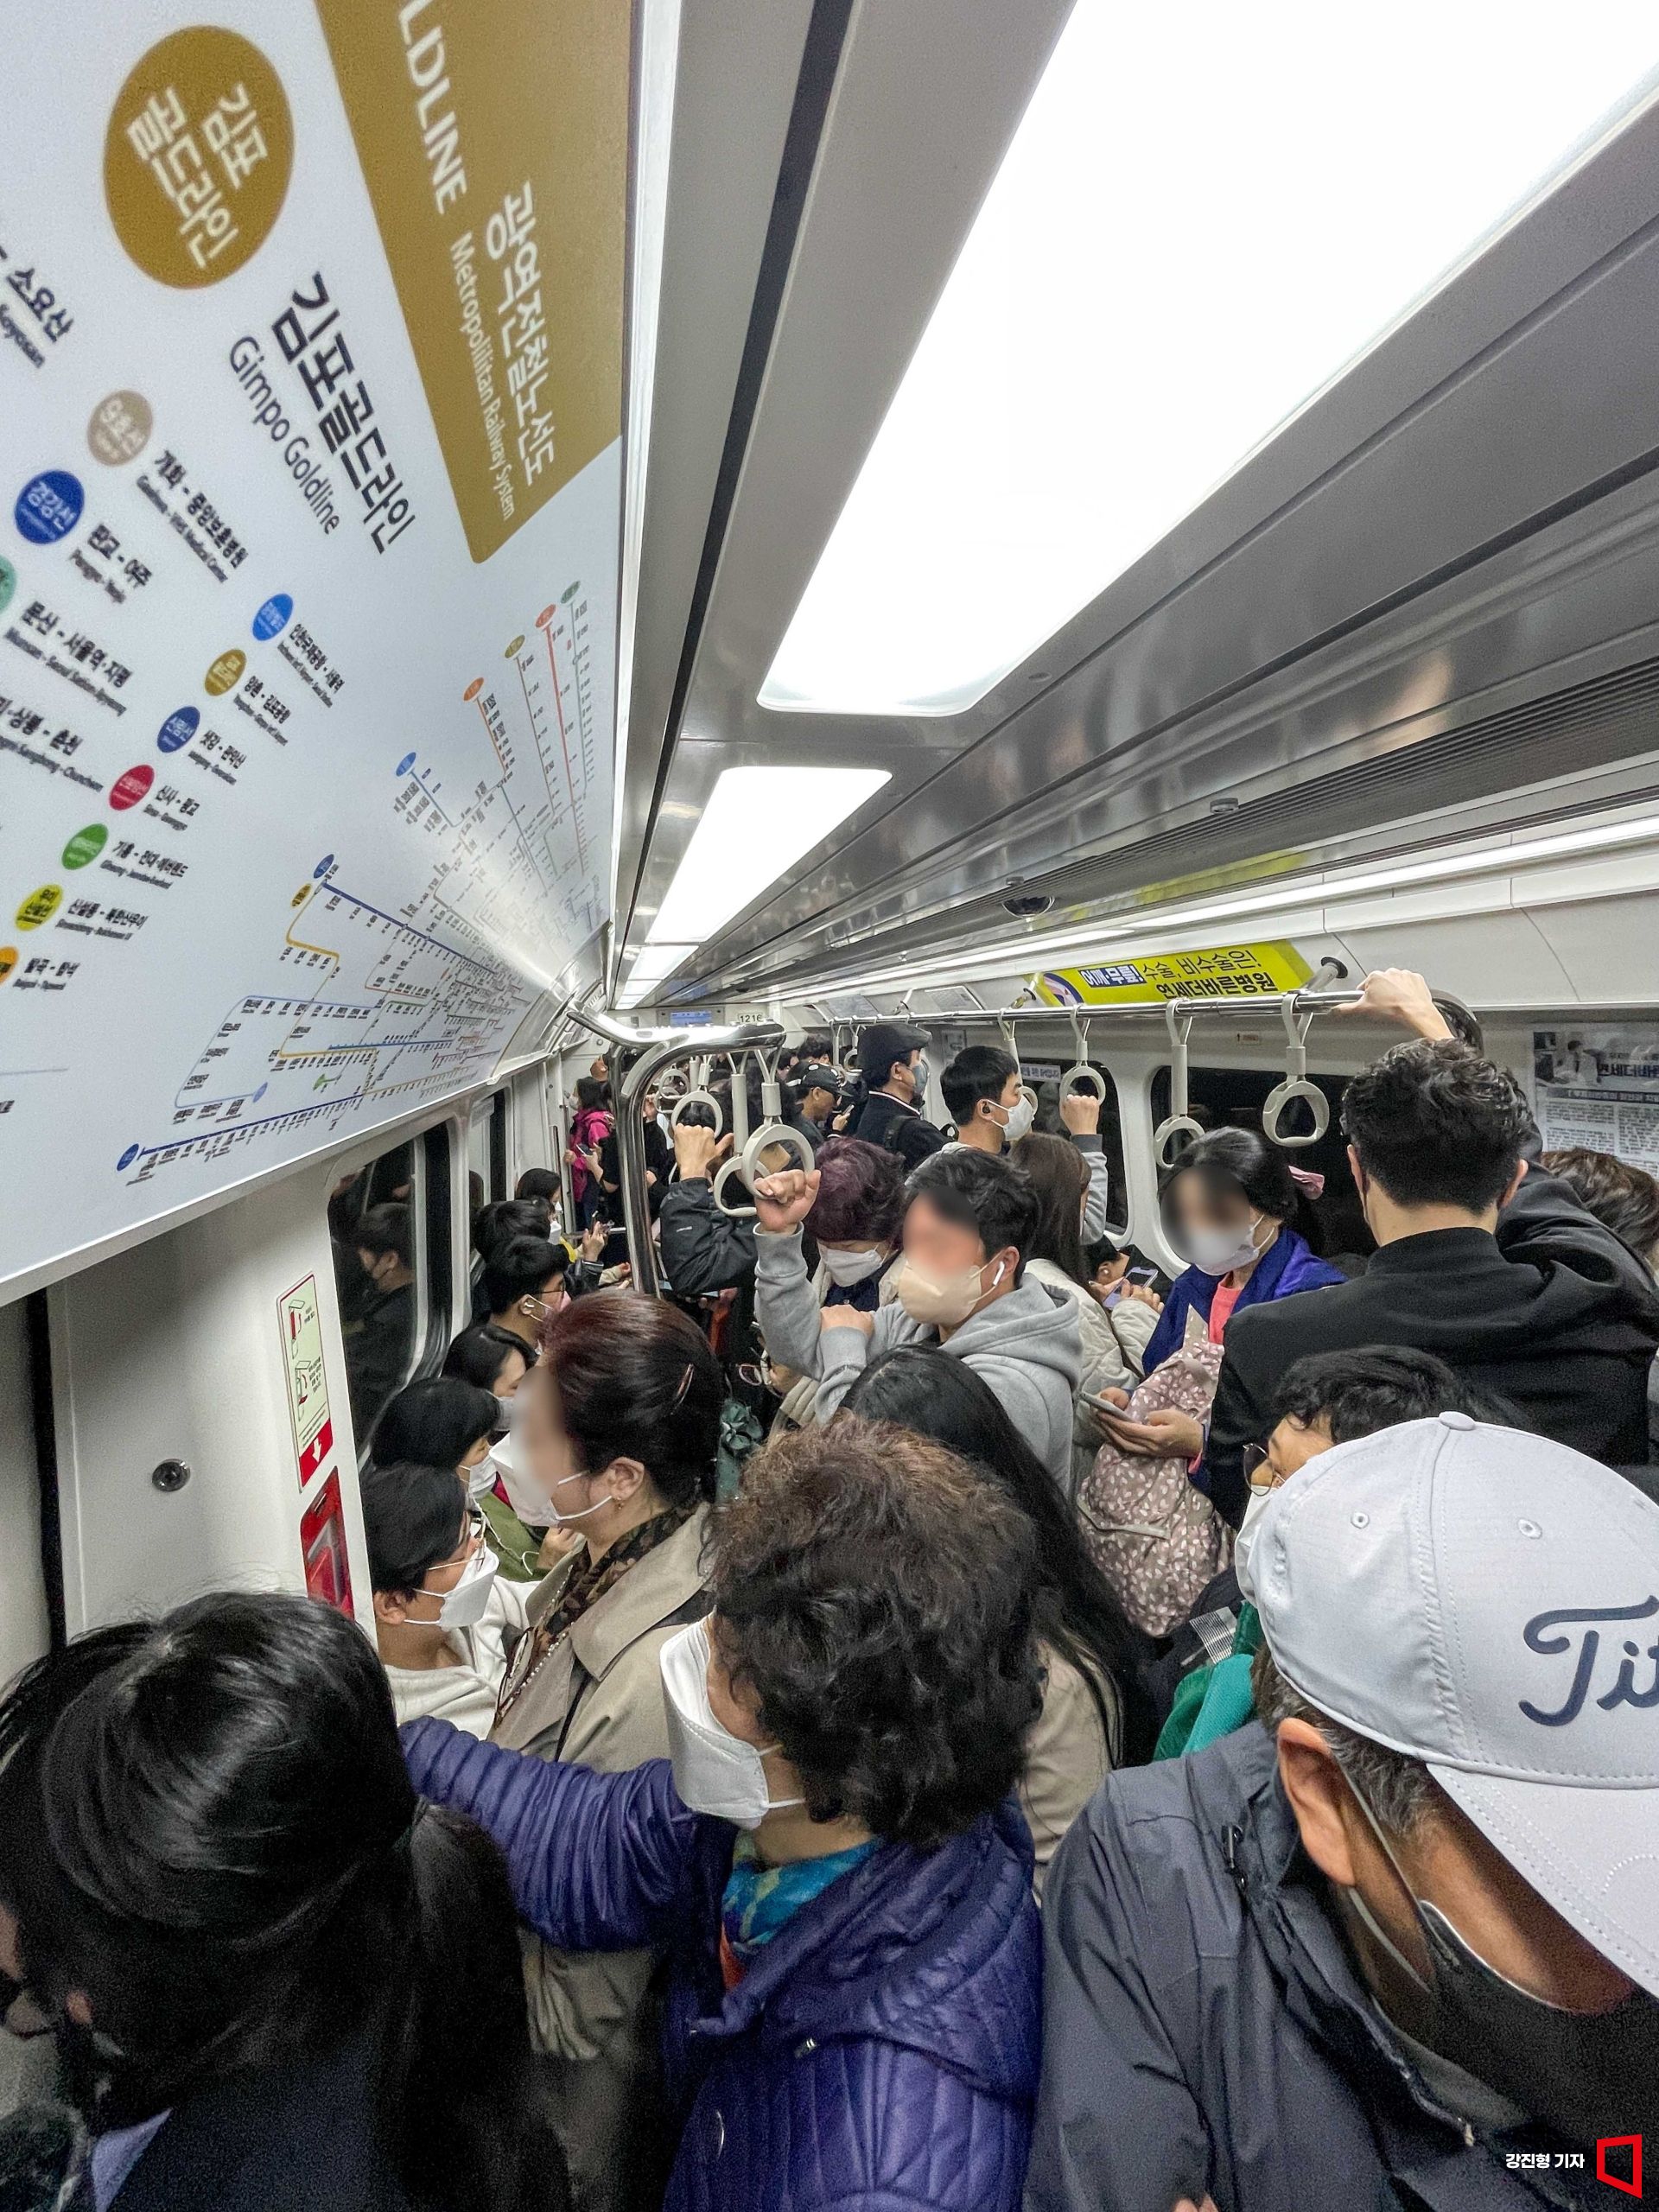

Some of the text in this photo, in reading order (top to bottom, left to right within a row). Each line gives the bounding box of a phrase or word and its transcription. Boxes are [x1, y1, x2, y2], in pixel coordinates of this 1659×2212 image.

[127, 86, 239, 269] 골드라인
[202, 83, 268, 190] 김포
[6, 267, 74, 343] 소요산
[486, 181, 555, 486] 광역전철노선도
[229, 335, 340, 536] Gimpo Goldline
[271, 270, 416, 555] 김포골드라인
[482, 397, 506, 472] Railway
[493, 463, 516, 521] System
[1142, 962, 1181, 980] 수술,
[1176, 950, 1262, 975] 비수술은!
[1156, 972, 1278, 999] 연세더바른병원
